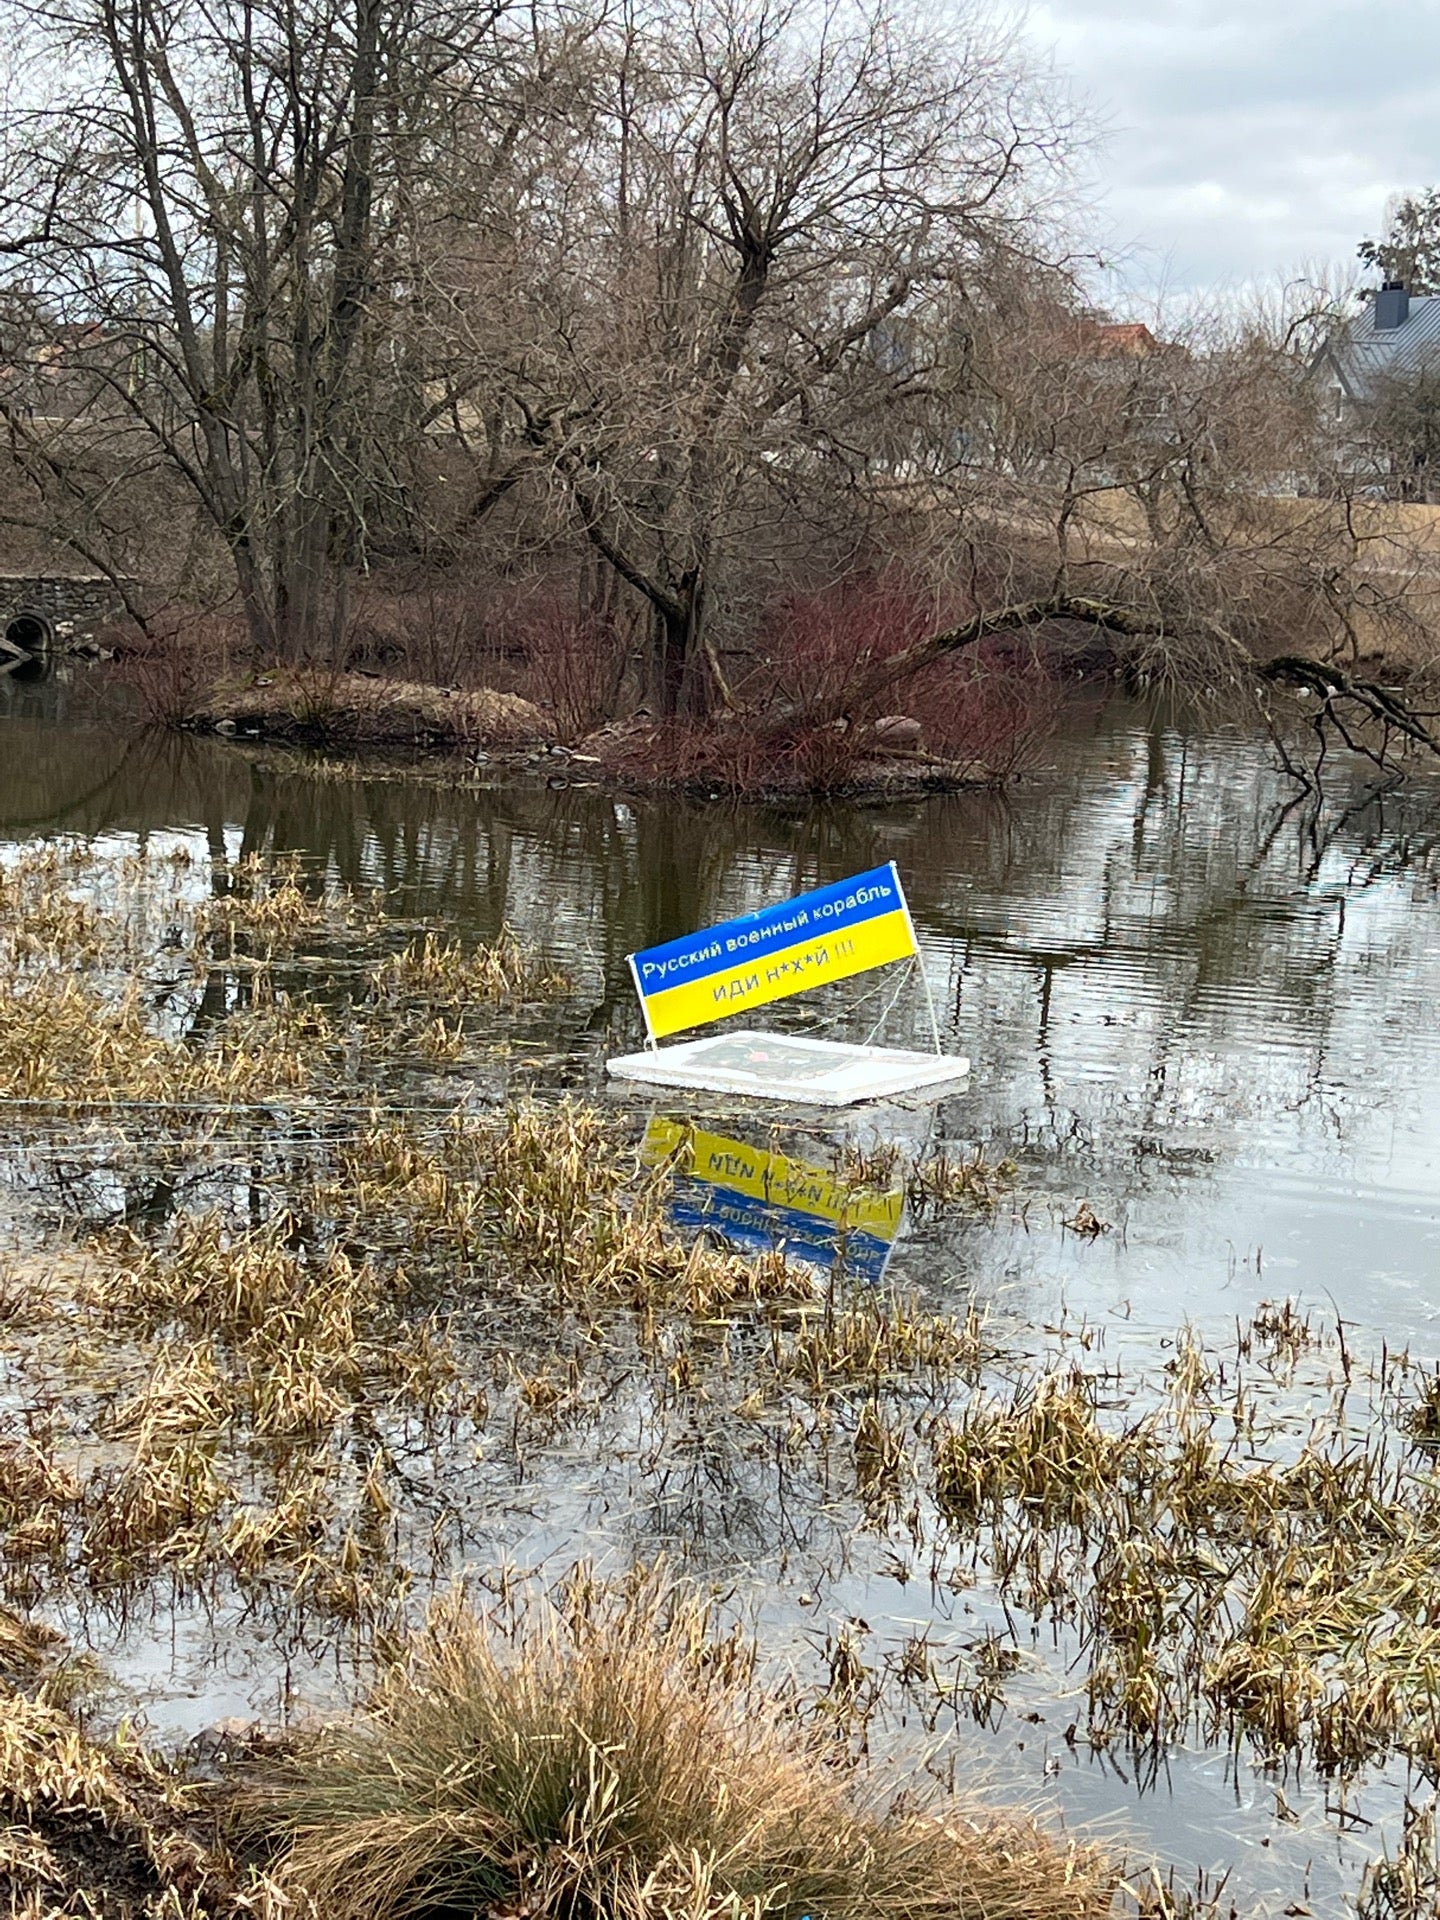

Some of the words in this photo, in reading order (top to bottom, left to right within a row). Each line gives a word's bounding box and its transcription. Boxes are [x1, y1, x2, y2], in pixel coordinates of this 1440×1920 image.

[642, 942, 721, 979] Русский
[726, 912, 808, 952] военный
[812, 884, 891, 921] корабль
[834, 939, 855, 961] !!!
